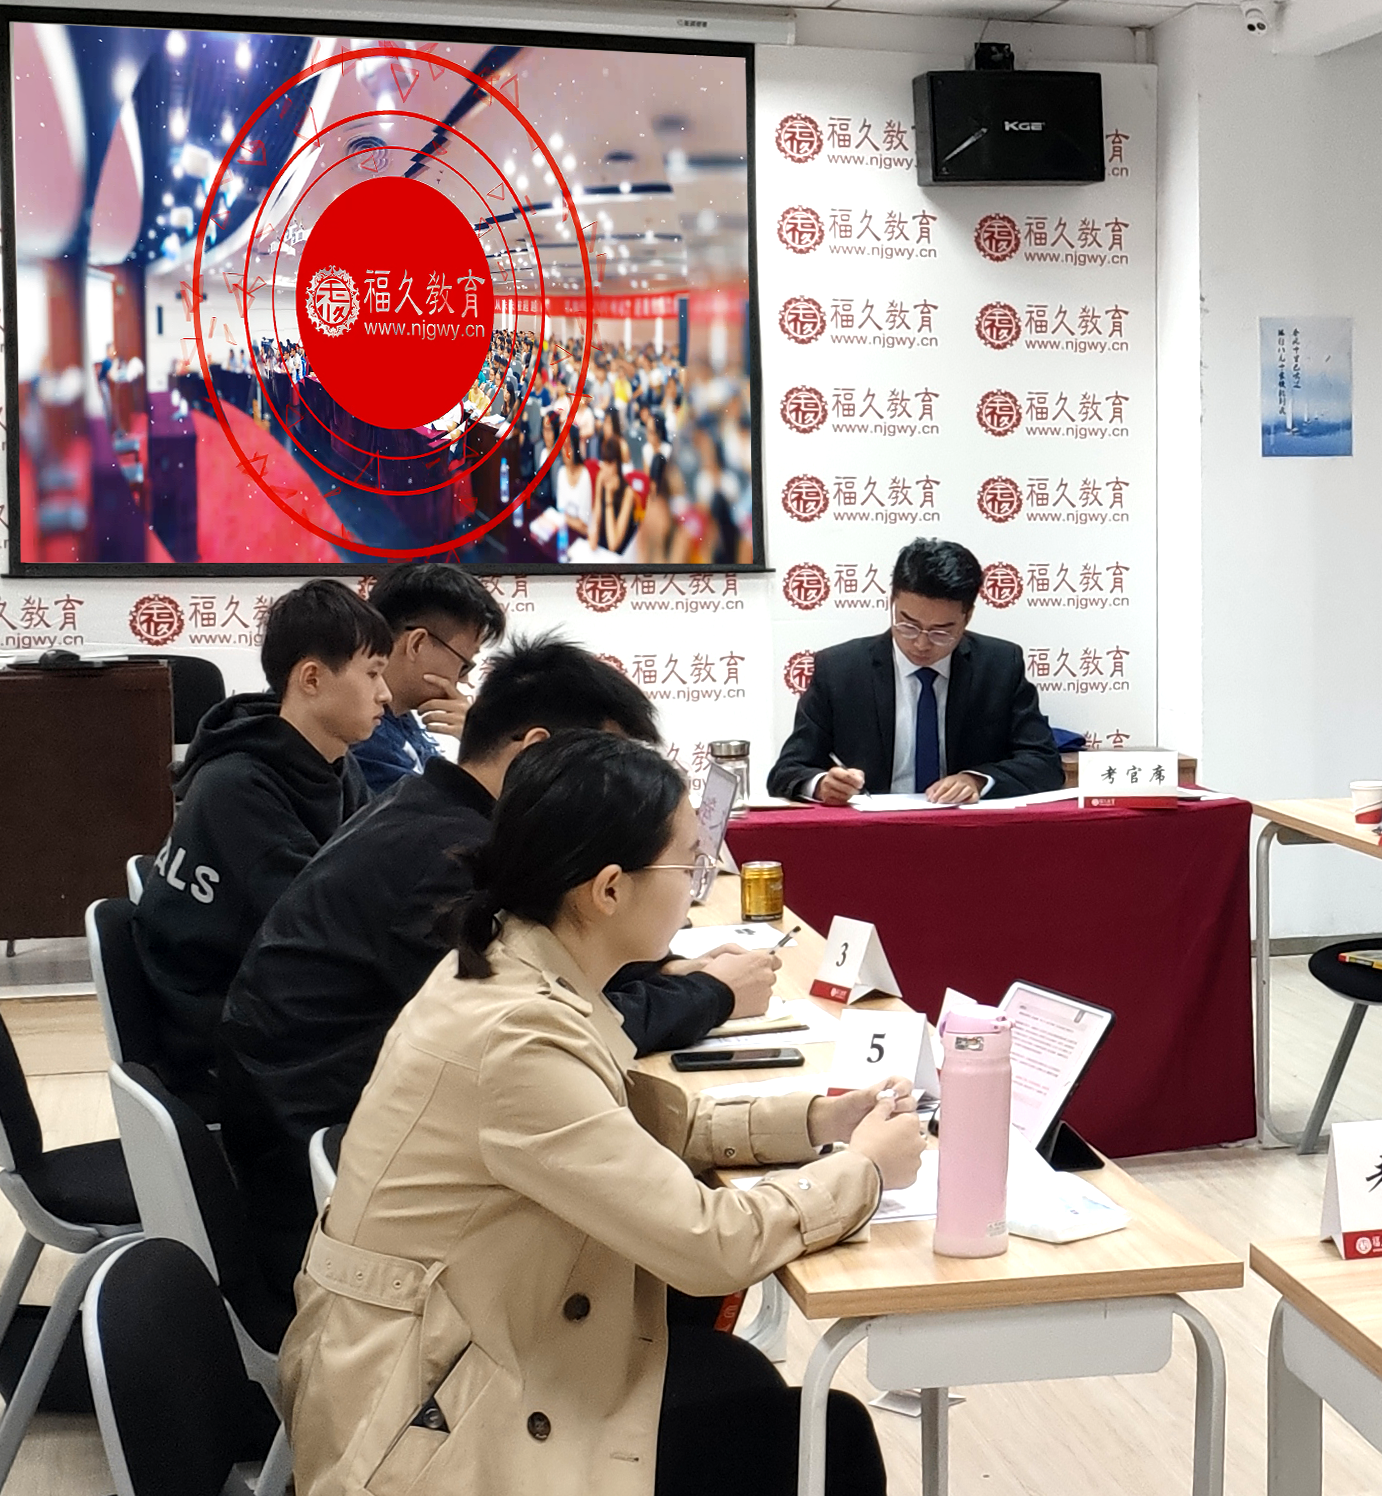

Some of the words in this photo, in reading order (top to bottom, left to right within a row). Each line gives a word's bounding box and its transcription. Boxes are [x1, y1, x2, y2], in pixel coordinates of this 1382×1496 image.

[829, 208, 937, 245] 福久教育
[1025, 216, 1129, 251] 福久教育
[829, 245, 937, 260] www.njgwy.cn
[1025, 251, 1129, 266] www.njgwy.cn
[364, 269, 485, 318] 福久教育
[831, 299, 938, 333] 福久教育
[1025, 304, 1129, 338] 福久教育
[364, 320, 485, 340] www.njgwy.cn
[830, 333, 938, 348] www.njgwy.cn
[1025, 338, 1129, 353] www.njgwy.cn
[832, 387, 940, 421] 福久教育
[1026, 391, 1129, 424] 福久教育
[832, 422, 939, 437] www.njgwy.cn
[1026, 424, 1129, 439] www.njgwy.cn
[833, 474, 940, 508] 福久教育
[1026, 476, 1130, 509] 福久教育
[833, 509, 940, 525] www.njgwy.cn
[1026, 510, 1130, 525] www.njgwy.cn
[1027, 561, 1130, 594] 福久教育
[631, 598, 744, 612] www.njgwy.cn
[1027, 595, 1130, 609] www.njgwy.cn
[632, 651, 745, 685] 福久教育
[1028, 645, 1130, 678] 福久教育
[1101, 764, 1165, 786] 考官席
[836, 942, 848, 967] 3
[867, 1033, 886, 1063] 5
